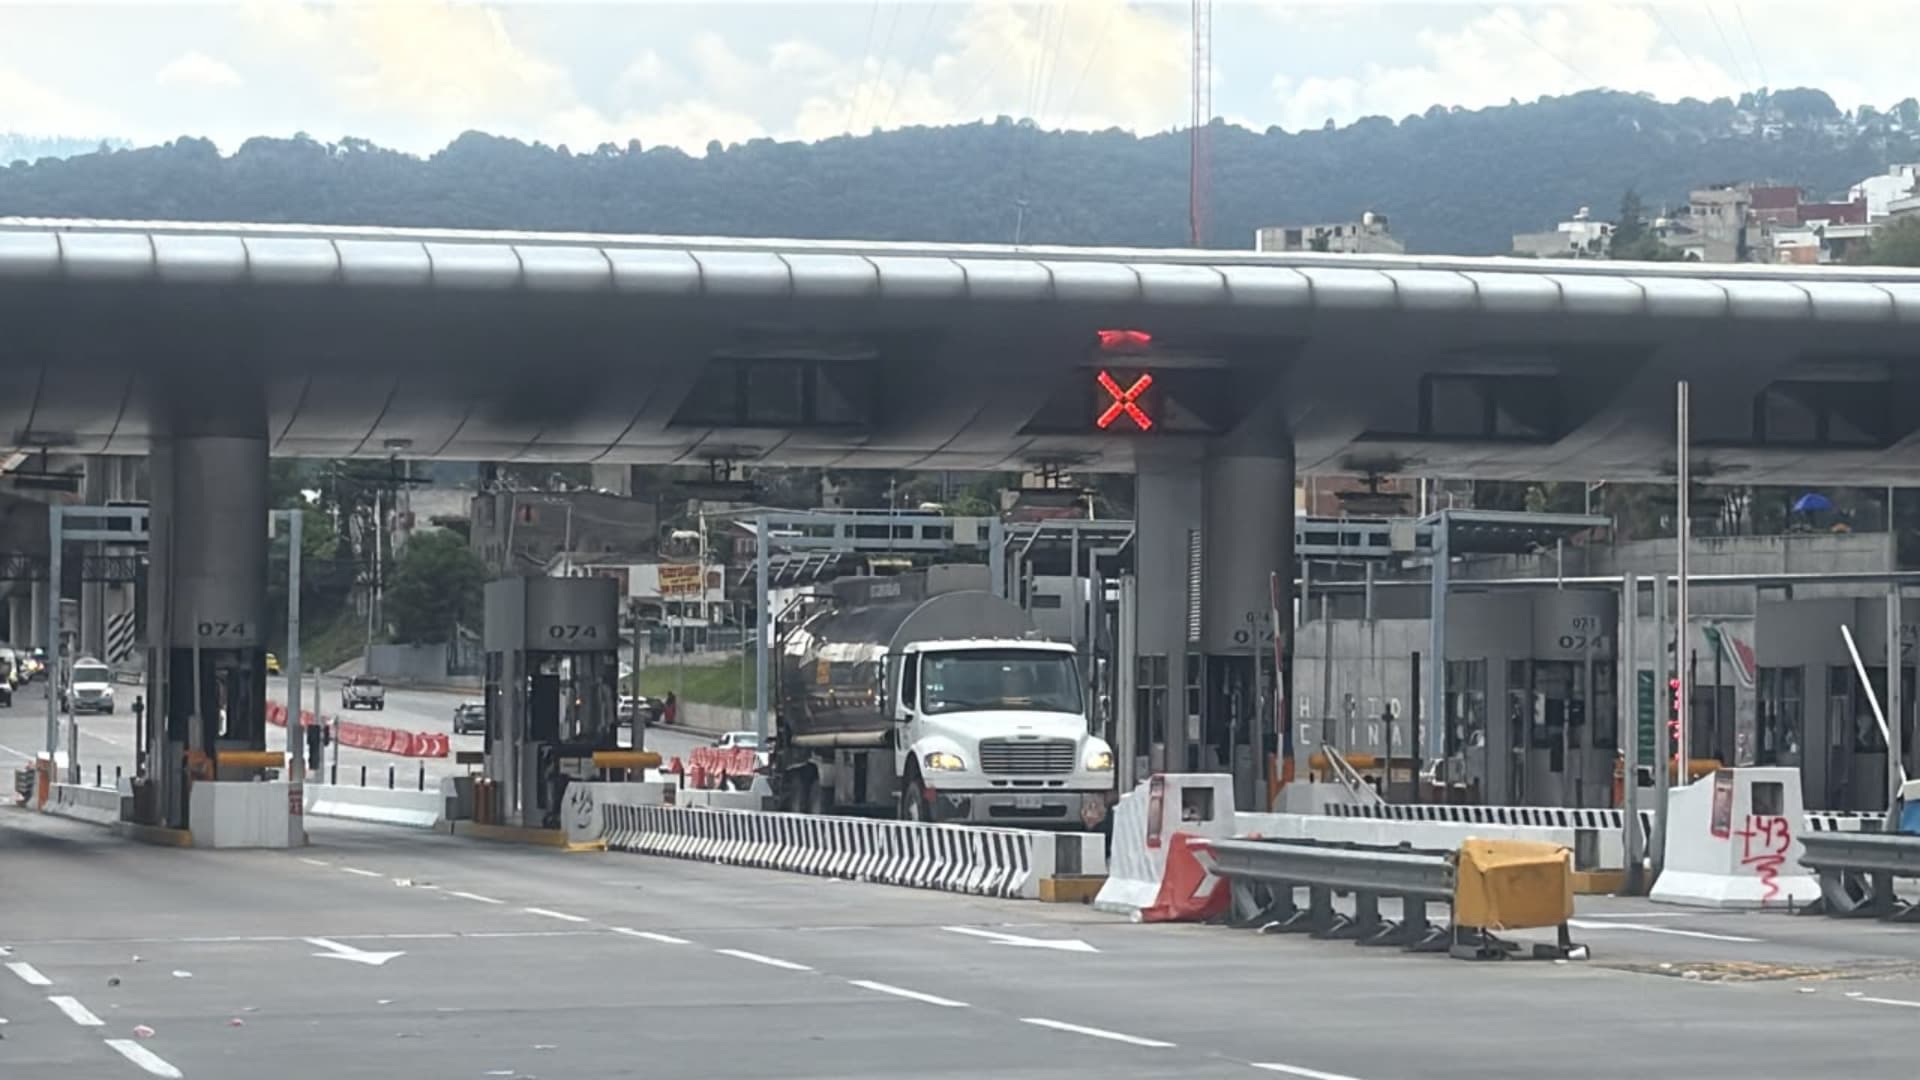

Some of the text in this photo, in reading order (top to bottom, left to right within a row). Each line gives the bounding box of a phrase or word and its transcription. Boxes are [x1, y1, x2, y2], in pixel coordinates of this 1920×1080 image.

[198, 622, 245, 637] 074
[549, 625, 597, 639] 074
[1559, 635, 1602, 649] 074
